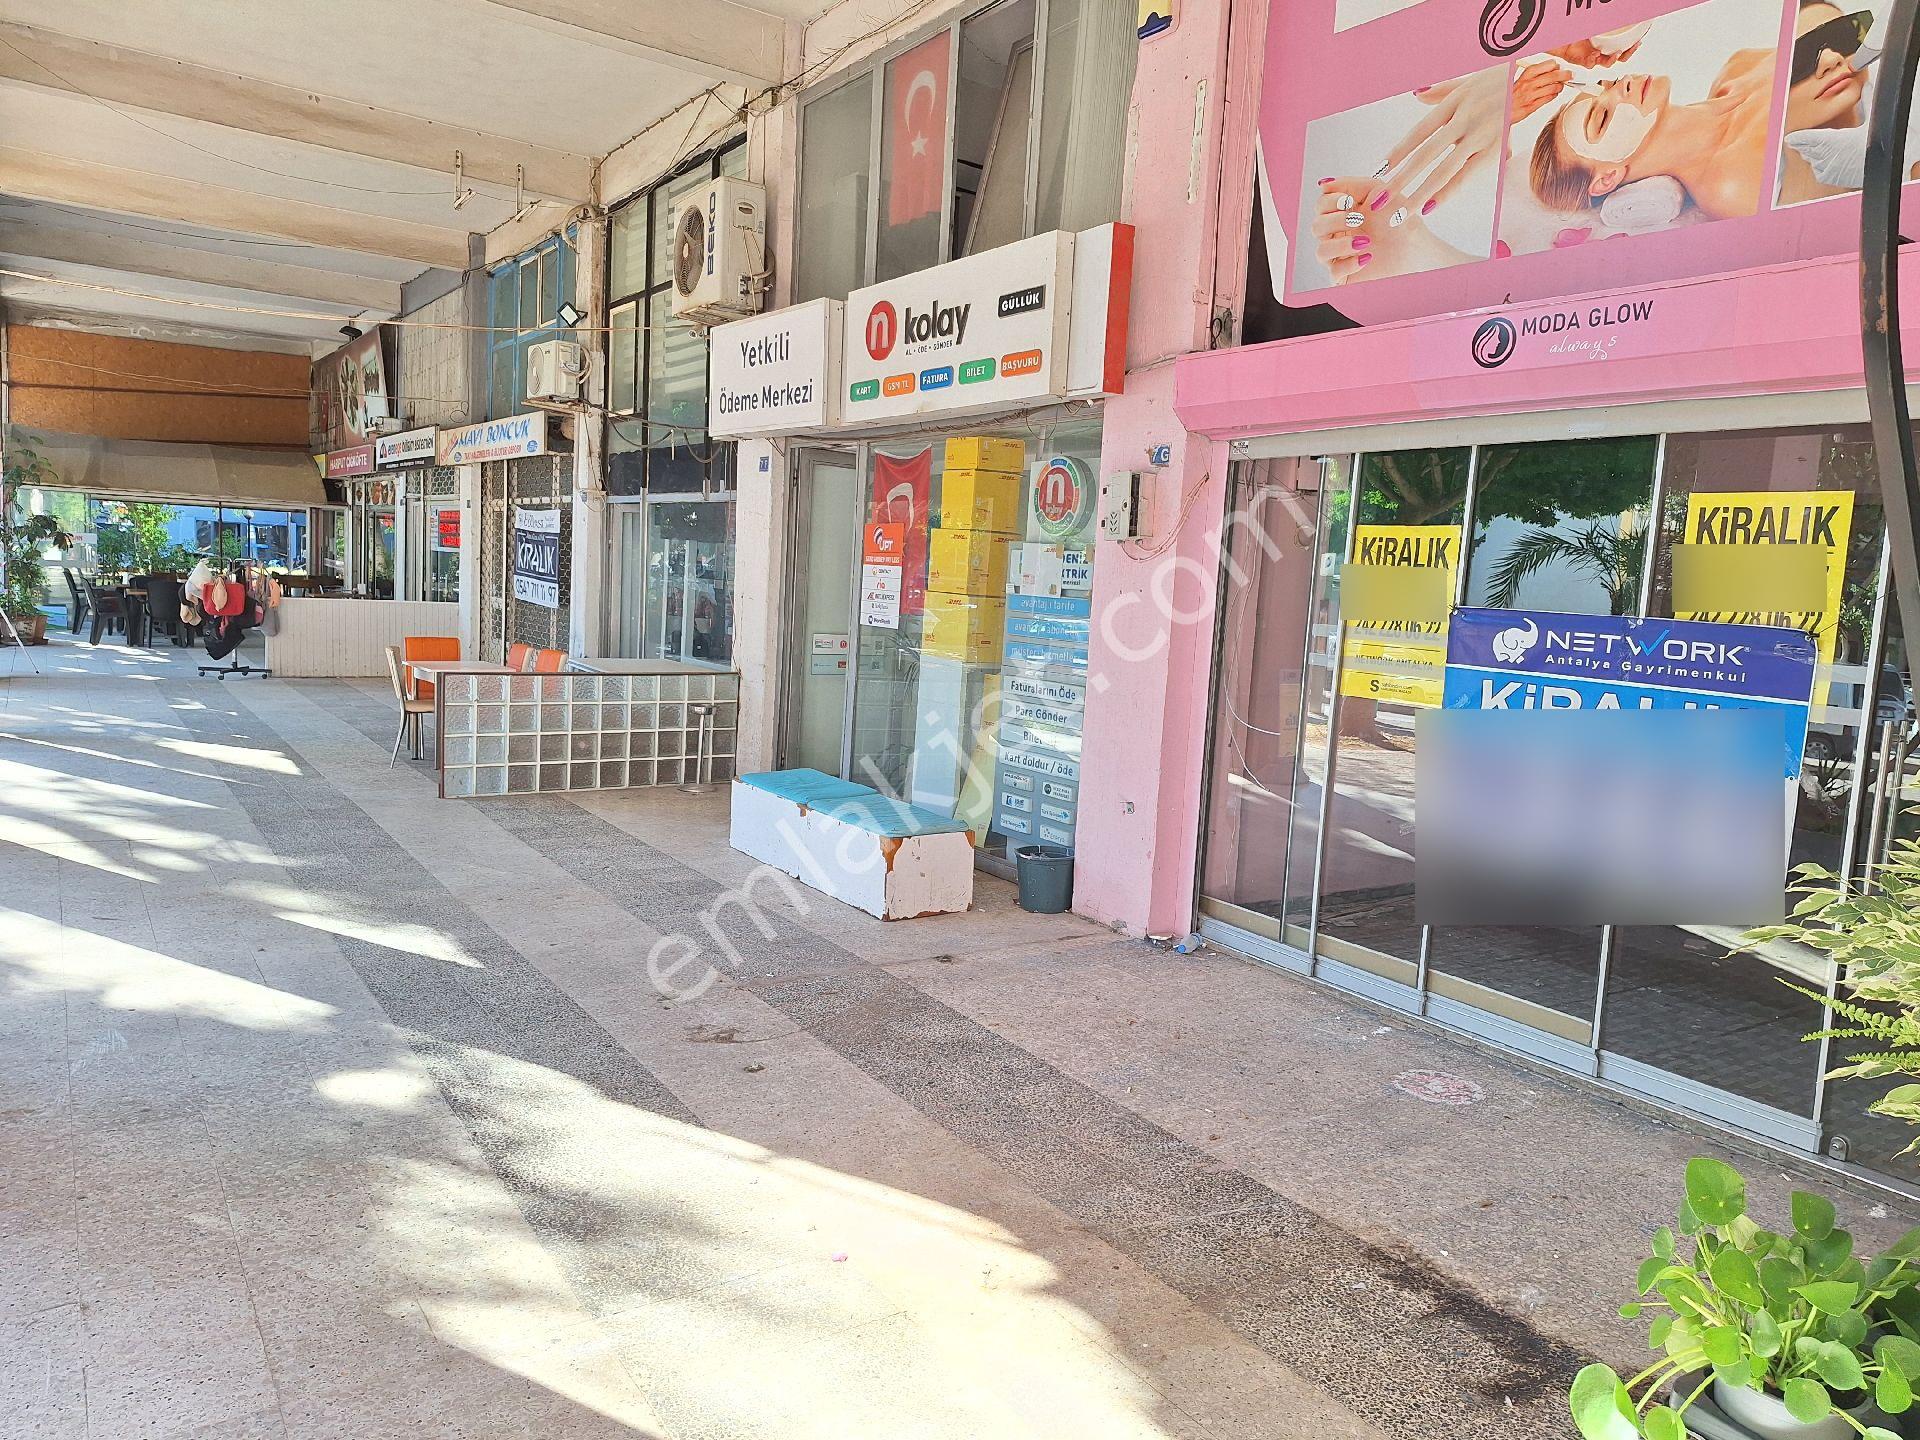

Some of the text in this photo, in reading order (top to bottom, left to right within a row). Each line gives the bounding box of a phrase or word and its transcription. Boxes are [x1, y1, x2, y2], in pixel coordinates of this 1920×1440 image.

[707, 192, 716, 275] BEKO
[1001, 291, 1040, 312] GÜLLÜK
[904, 300, 971, 346] kolay
[1521, 300, 1654, 336] MODA GLOW
[741, 331, 789, 368] Yetkili
[966, 366, 986, 378] BİLET
[1002, 356, 1040, 374] BAŞVURU
[856, 385, 872, 396] KART
[922, 371, 949, 385] FATURA
[720, 378, 813, 414] Ödeme Merkezi
[1546, 630, 1745, 666] NETWORK
[1545, 654, 1746, 683] Antalya Gayrimenkul
[1011, 680, 1076, 700] Faturalarını Öde
[1015, 705, 1068, 723] Para Gönder
[1004, 751, 1021, 763] Kart
[1022, 755, 1049, 771] doldur
[1057, 762, 1073, 776] öde
